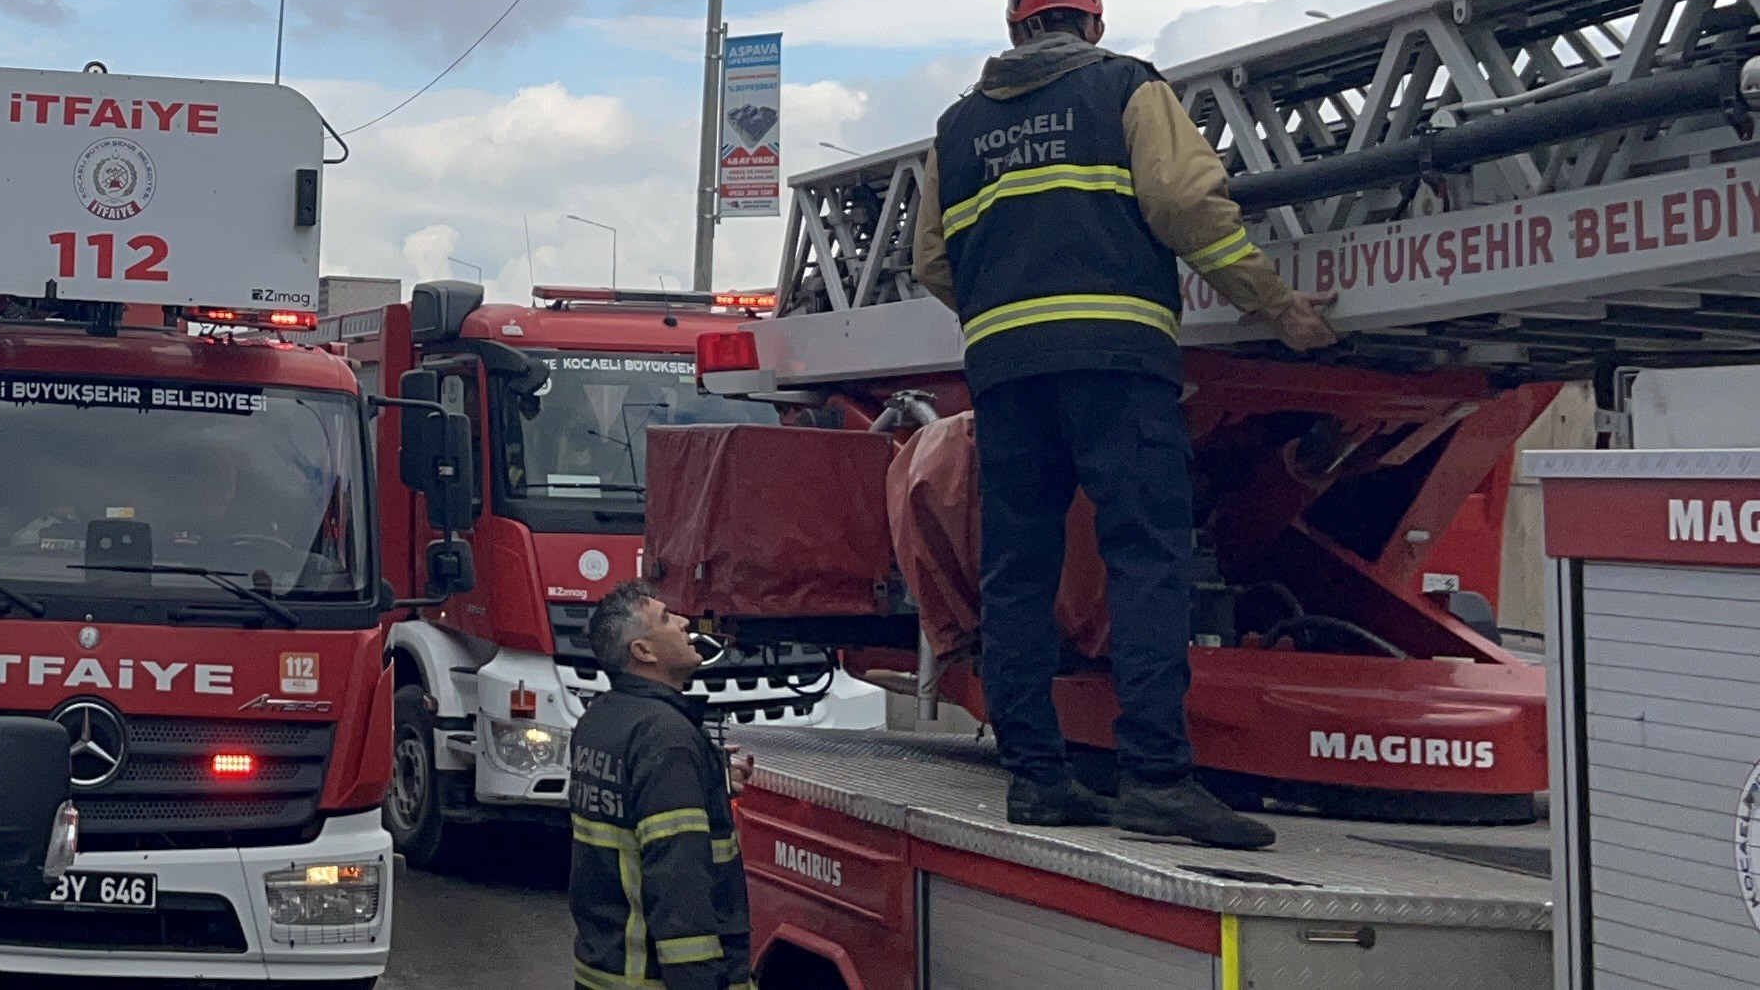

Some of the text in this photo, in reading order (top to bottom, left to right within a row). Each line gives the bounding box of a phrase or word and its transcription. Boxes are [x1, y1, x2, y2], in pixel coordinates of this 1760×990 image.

[728, 43, 779, 58] ASPAVA
[973, 107, 1073, 156] KOCAELİ
[49, 231, 169, 282] 112
[1315, 205, 1554, 293] BÜYÜKŞEHİR
[265, 289, 310, 307] Zimag
[625, 359, 697, 374] BÜYÜKŞEH
[285, 657, 314, 677] 112
[1309, 730, 1495, 769] MAGIRUS
[774, 839, 843, 888] MAGIRUS
[101, 877, 146, 904] 646
